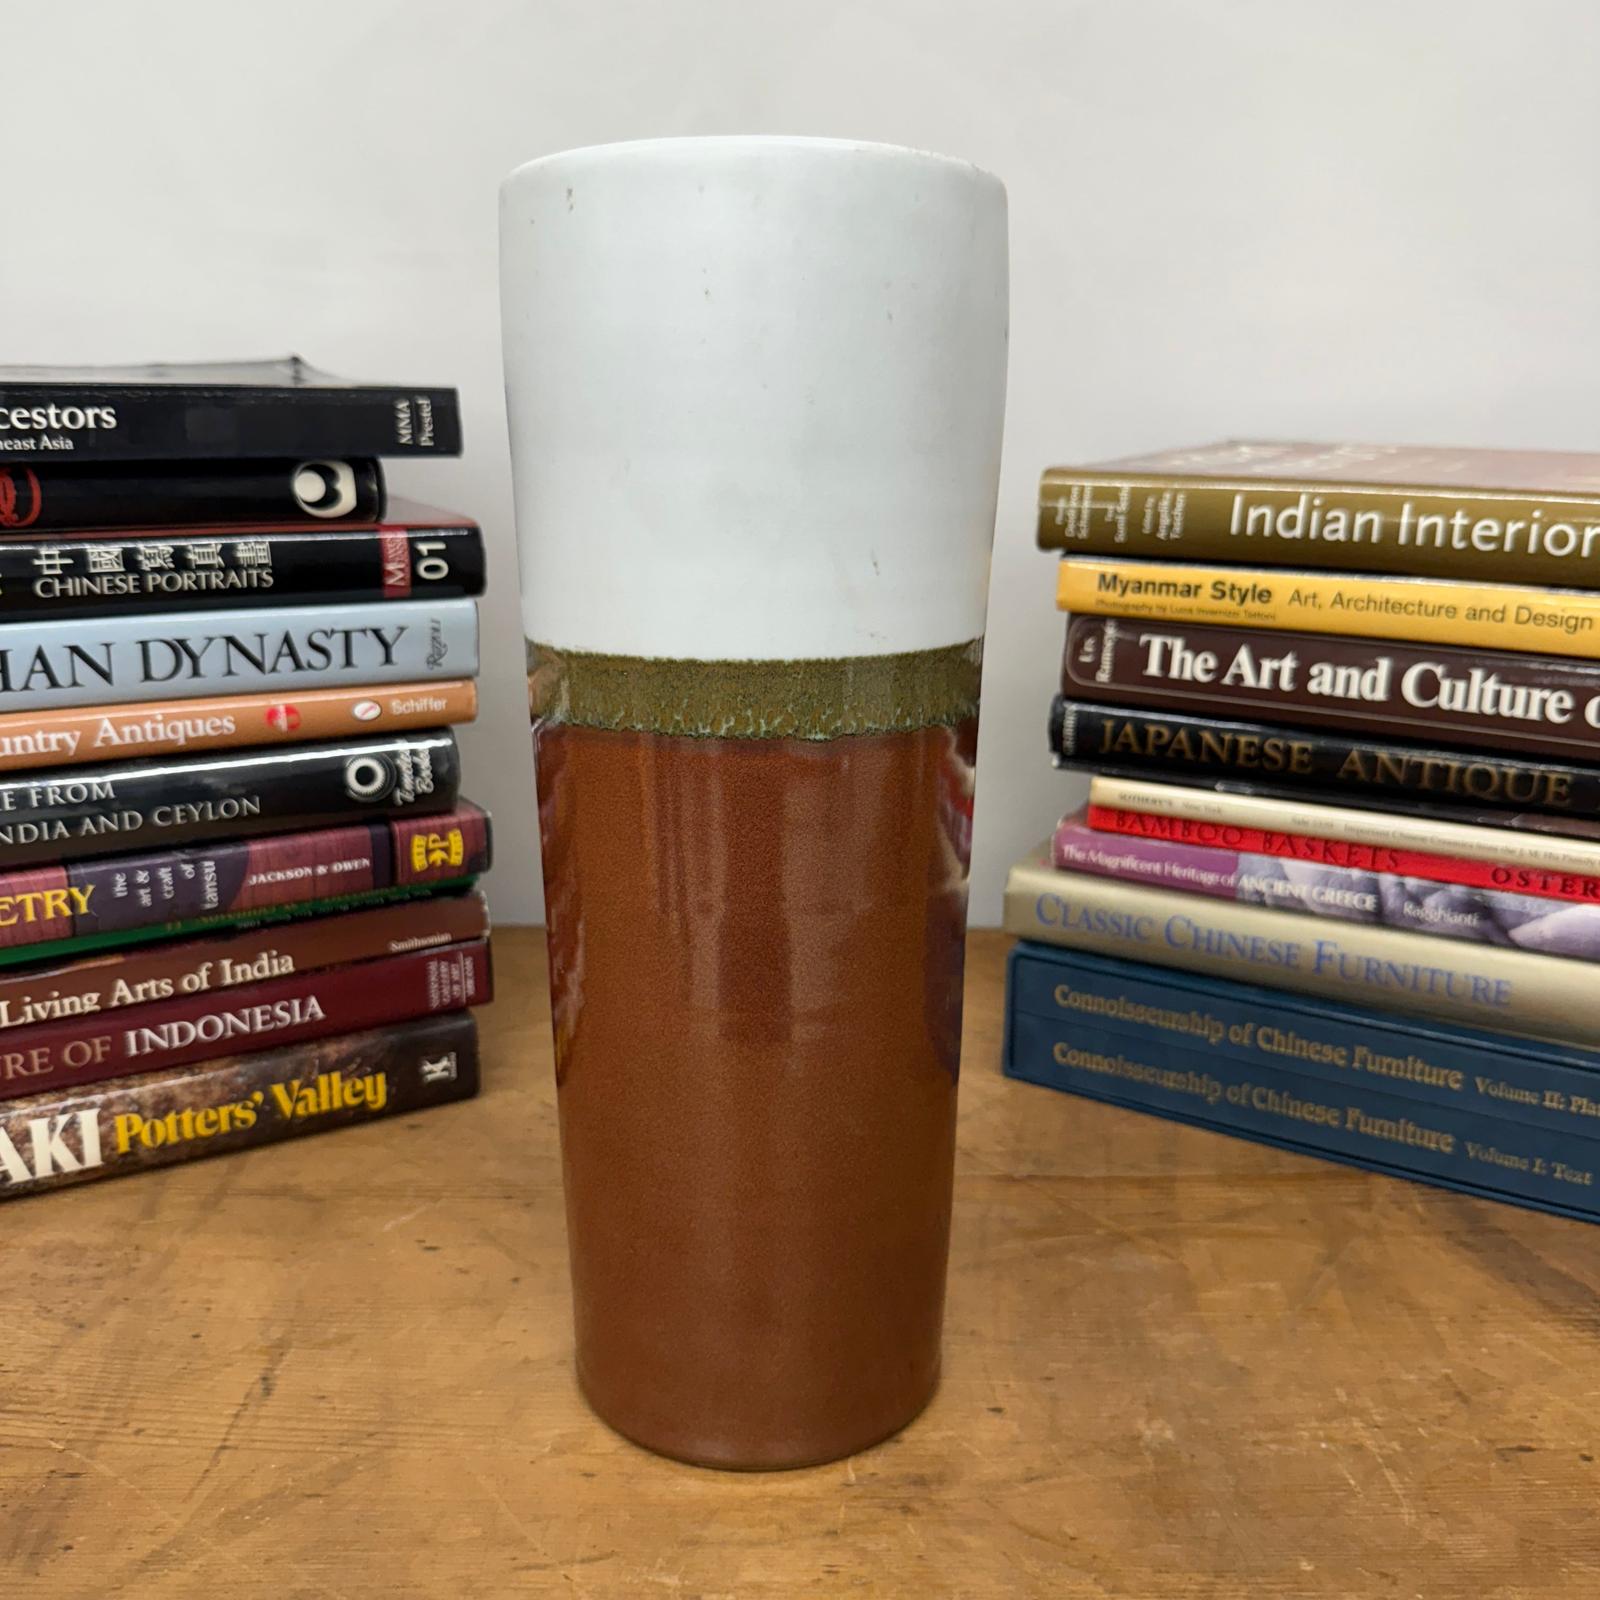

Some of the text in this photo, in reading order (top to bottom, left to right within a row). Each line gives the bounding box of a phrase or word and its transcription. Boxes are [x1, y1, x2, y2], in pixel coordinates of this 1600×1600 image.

[40, 434, 75, 451] Asia
[393, 399, 413, 445] MMA
[1230, 492, 1382, 544] Indian
[35, 568, 274, 598] CHINESE PORTRAITS
[415, 541, 449, 580] 01
[1098, 573, 1594, 635] Myanmar Style Art, Architecture and Design
[136, 626, 409, 683] DYNASTY
[1139, 633, 1219, 684] The
[1220, 643, 1300, 692] Art
[1307, 656, 1395, 702] and
[1401, 660, 1576, 725] Culture
[94, 714, 236, 747] Antiques
[391, 697, 447, 716] Schiffer
[1101, 718, 1314, 774] JAPANESE
[1337, 745, 1574, 807] ANTIQUE
[29, 781, 116, 808] FROM
[81, 809, 143, 837] AND
[153, 796, 260, 828] CEYLON
[1115, 809, 1244, 846] BAMBOO
[1261, 832, 1400, 869] BASKETS
[201, 861, 219, 910] tansu
[249, 858, 371, 886] JACKSON & OWEN
[1063, 844, 1086, 862] The
[1088, 850, 1163, 875] Magnificent
[1164, 860, 1220, 886] Heritage
[1220, 872, 1236, 887] of
[1236, 873, 1311, 898] ANCIENT
[1311, 885, 1378, 912] GREECE
[390, 932, 452, 952] Smithsonian
[1036, 892, 1513, 1007] CLASSIC CHINESE FURNITURE
[0, 949, 295, 1029] Living Arts of India
[64, 1036, 112, 1069] OF
[125, 995, 326, 1057] INDONESIA
[1053, 984, 1224, 1045] Connoisseurship
[1229, 1022, 1255, 1047] of
[1256, 1026, 1347, 1068] Chinese
[1352, 1045, 1464, 1091] Furniture
[1475, 1075, 1540, 1105] Volume
[114, 1090, 265, 1155] Potters'
[270, 1070, 388, 1121] Valley
[1052, 1042, 1222, 1105] Connoisseurship
[1226, 1083, 1251, 1107] of
[1252, 1086, 1340, 1127] Chinese
[1345, 1106, 1457, 1154] Furniture
[1464, 1140, 1529, 1172] Volume
[1552, 1161, 1593, 1186] Text
